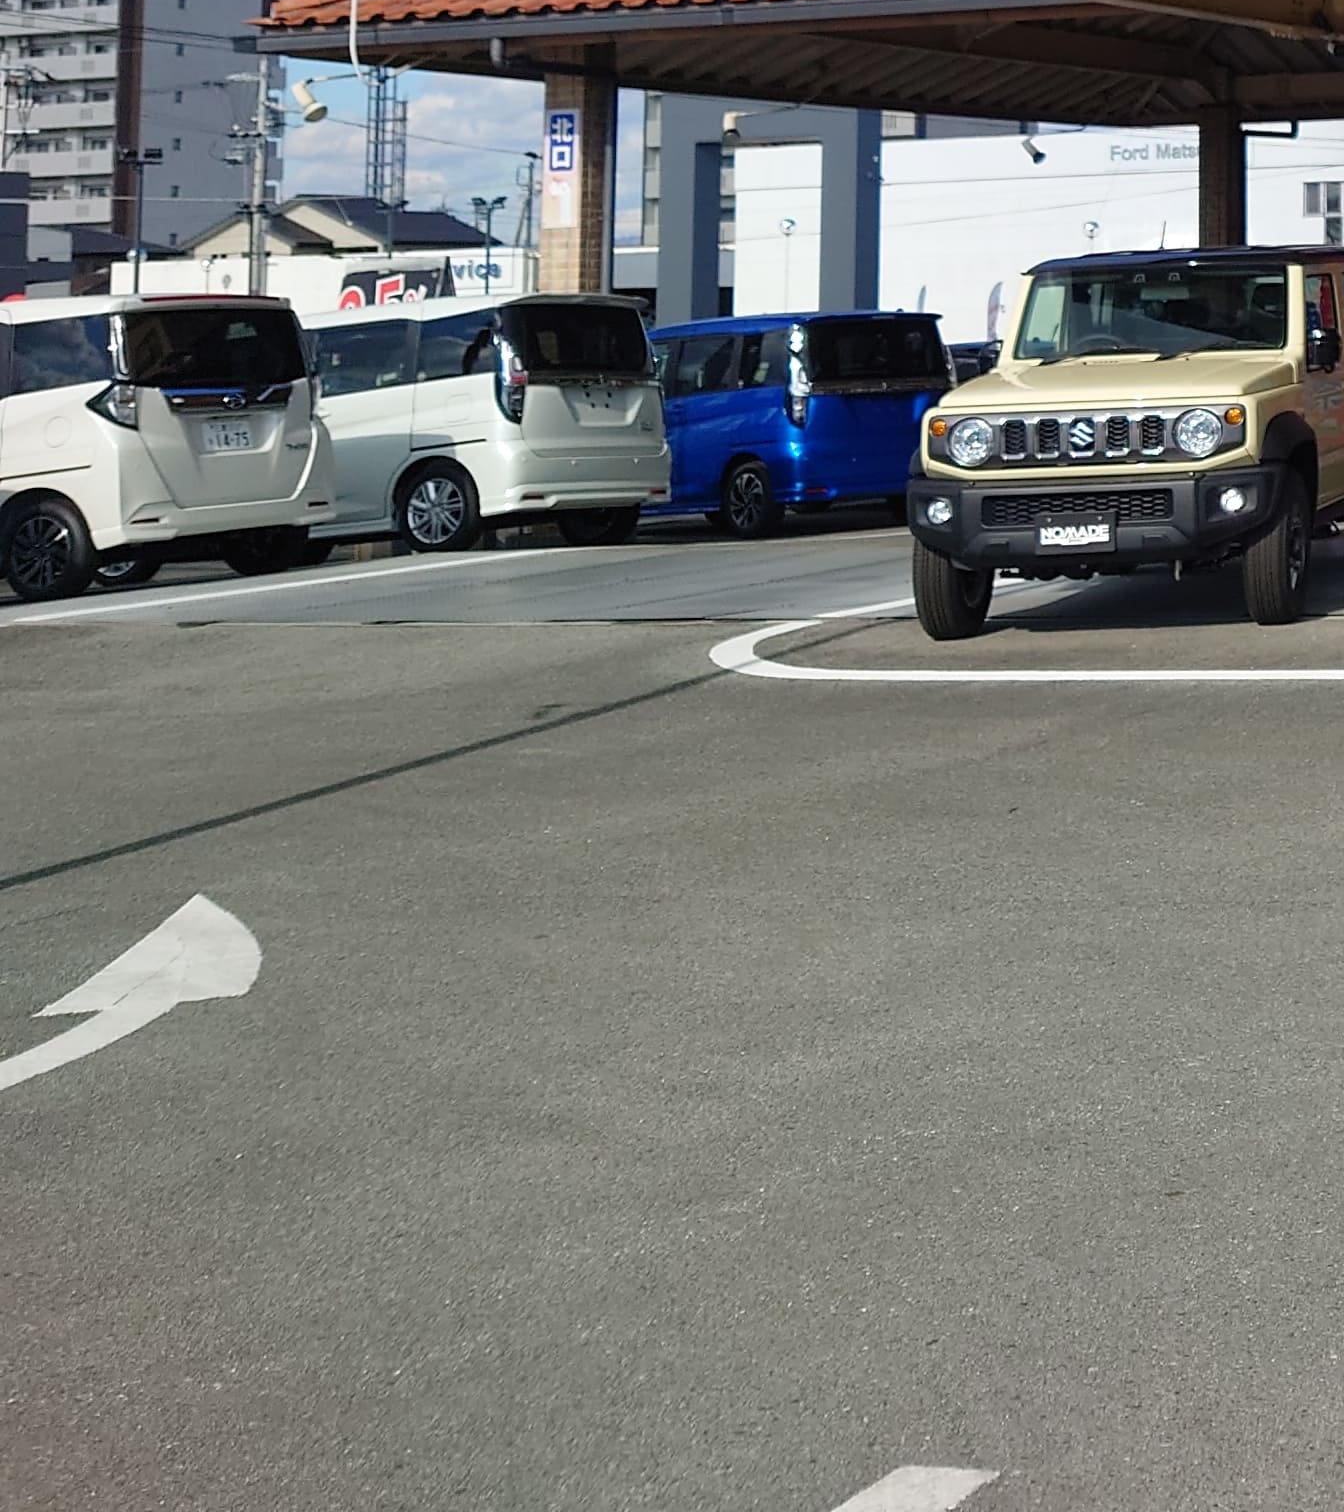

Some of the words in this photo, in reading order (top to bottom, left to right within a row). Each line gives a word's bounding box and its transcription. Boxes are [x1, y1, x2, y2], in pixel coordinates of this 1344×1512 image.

[551, 116, 573, 168] 北口
[1110, 143, 1149, 161] Ford
[1156, 143, 1199, 159] Mats
[1040, 524, 1110, 540] NOMADE
